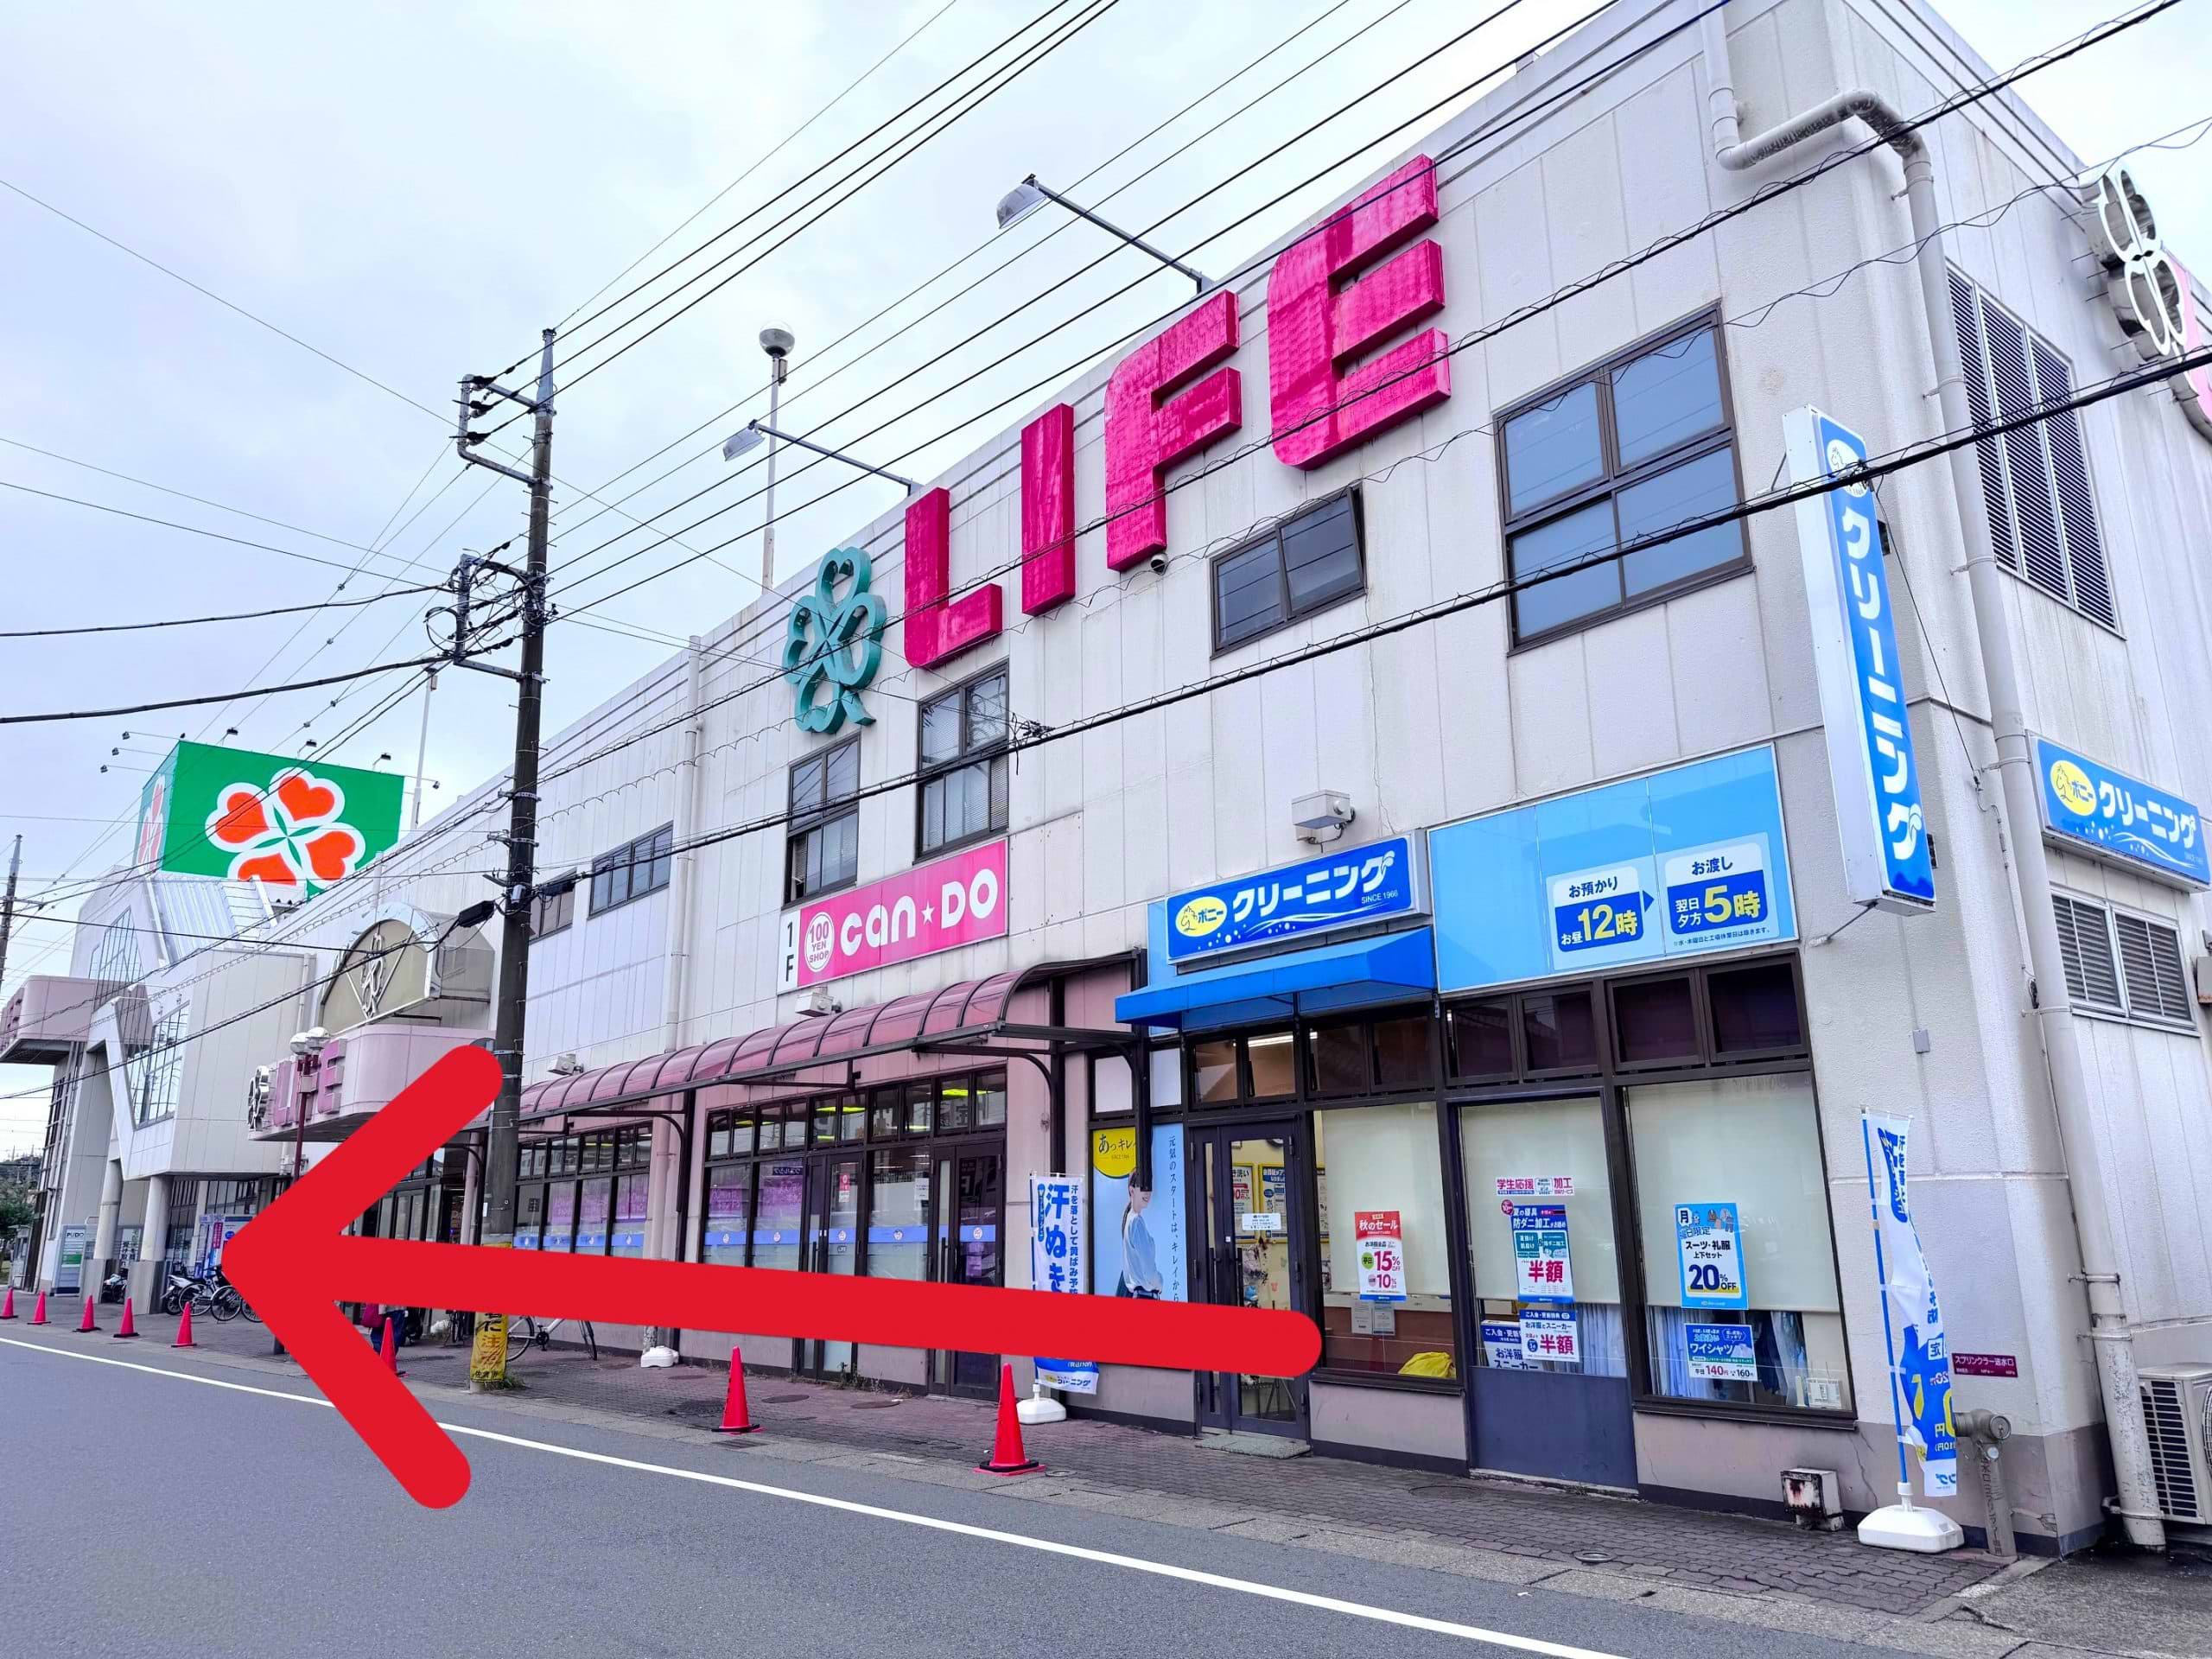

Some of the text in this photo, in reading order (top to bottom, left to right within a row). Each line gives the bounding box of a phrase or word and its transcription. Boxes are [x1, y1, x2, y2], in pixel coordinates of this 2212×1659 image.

[904, 154, 1451, 669] LIFE
[1842, 506, 1922, 861] クリーニング
[2071, 780, 2196, 849] ポニー クリーニング
[1691, 855, 1733, 875] お渡し
[1198, 850, 1395, 924] ポニー クリーニング
[1361, 889, 1398, 904] SINCE 1966
[1568, 876, 1618, 899] お預かり
[810, 920, 830, 944] 100
[811, 941, 827, 950] YEN
[809, 949, 830, 963] SHOP
[1098, 1134, 1135, 1154] あっキレ
[1497, 1179, 1534, 1190] 学生応援
[1554, 1178, 1573, 1189] 加工
[1359, 1219, 1398, 1230] 秋のセール
[1528, 1260, 1563, 1283] 半額
[1688, 1264, 1728, 1290] 20%
[1485, 1328, 1521, 1337] ご入会・更新
[1540, 1333, 1574, 1355] 半額
[1689, 1343, 1733, 1355] ワイシャツ
[1494, 1359, 1538, 1370] スニーカー
[1955, 1355, 2014, 1366] スプリンクラー送水口
